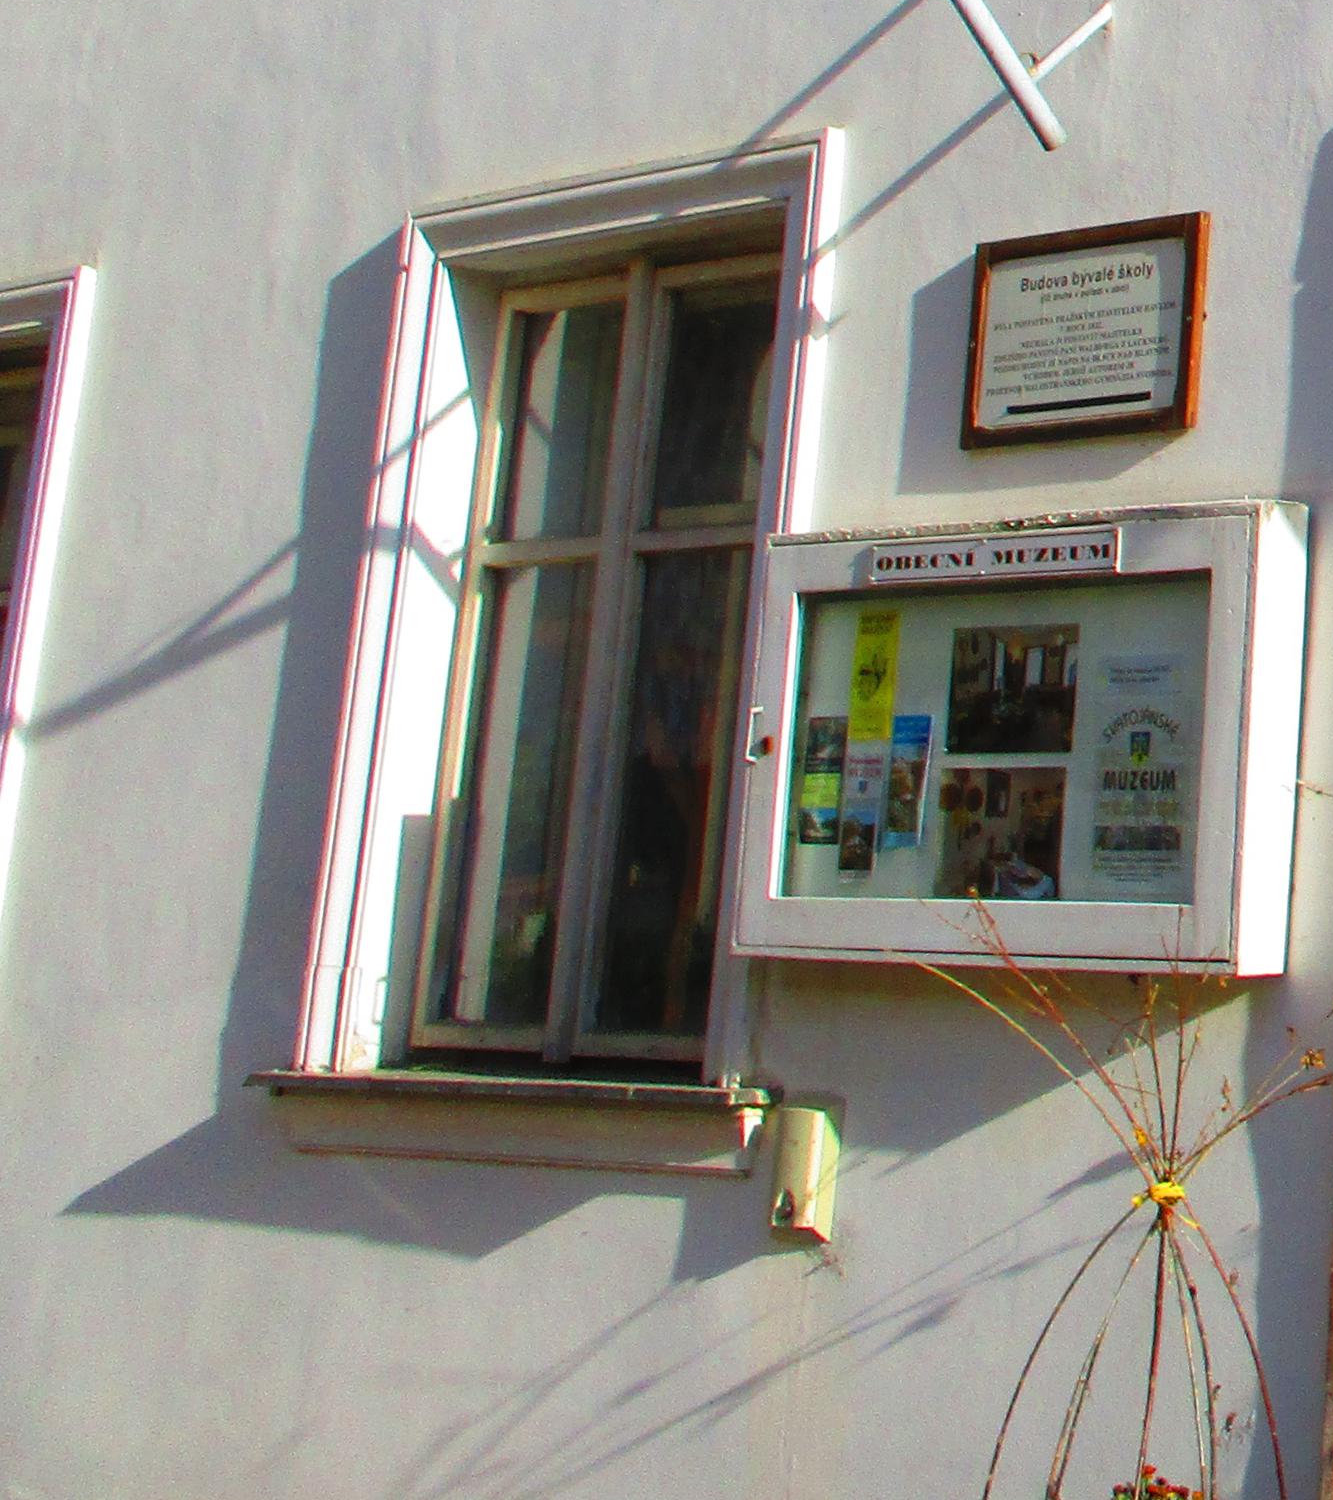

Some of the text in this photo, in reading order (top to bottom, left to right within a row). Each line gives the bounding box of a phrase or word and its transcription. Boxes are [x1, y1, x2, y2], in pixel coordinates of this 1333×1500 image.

[1020, 274, 1069, 293] Budova
[1117, 261, 1154, 280] školy
[876, 542, 1112, 572] OBECNÍ MUZEUM
[1103, 767, 1177, 792] MUZEUM
